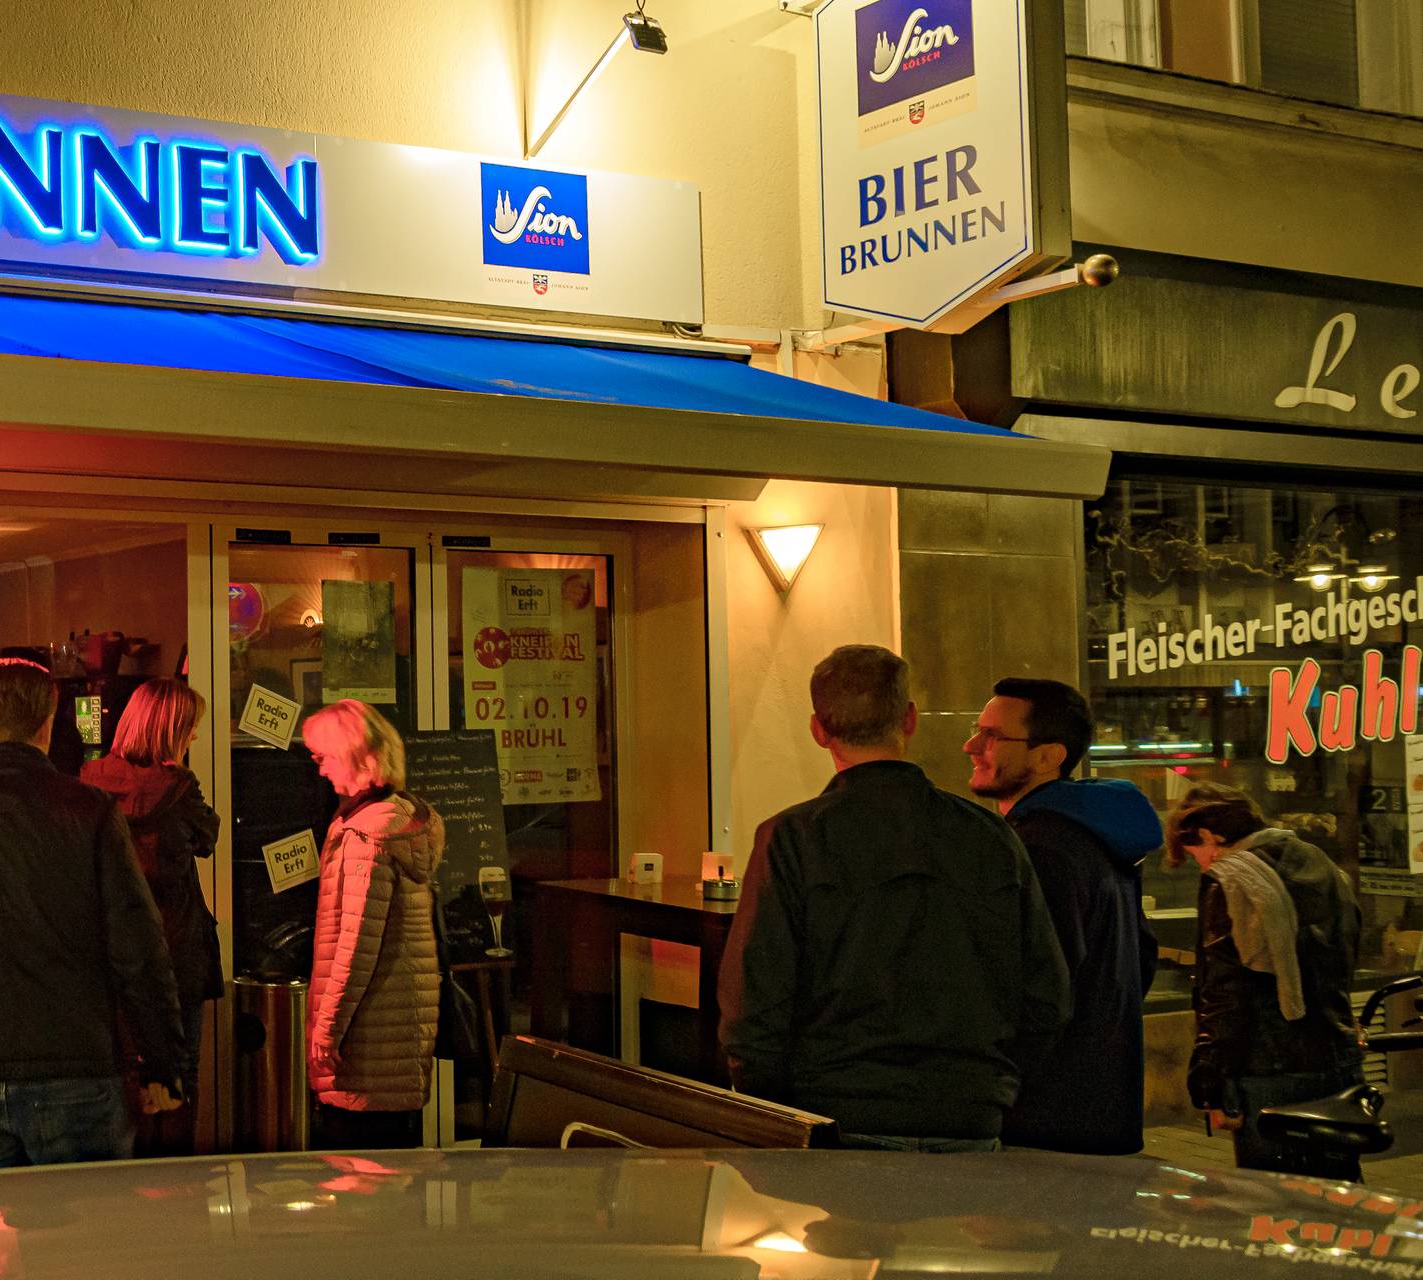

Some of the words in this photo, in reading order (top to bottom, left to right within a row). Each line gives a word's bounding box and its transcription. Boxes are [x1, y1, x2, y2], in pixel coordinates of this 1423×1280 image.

[869, 8, 959, 83] Sion
[902, 50, 941, 72] KÖLSCH
[858, 144, 982, 228] BIER
[489, 185, 583, 245] Sion
[524, 233, 565, 247] KÖLSCH
[840, 200, 1006, 276] BRUNNEN
[511, 585, 544, 597] Radio
[518, 599, 539, 610] Erft
[256, 697, 289, 721] Radio
[1265, 644, 1423, 764] Kuhl
[258, 713, 279, 731] Erft
[501, 723, 567, 749] BRÜHL
[1370, 788, 1387, 811] 2
[274, 844, 307, 864] Radio
[284, 857, 305, 876] Erft
